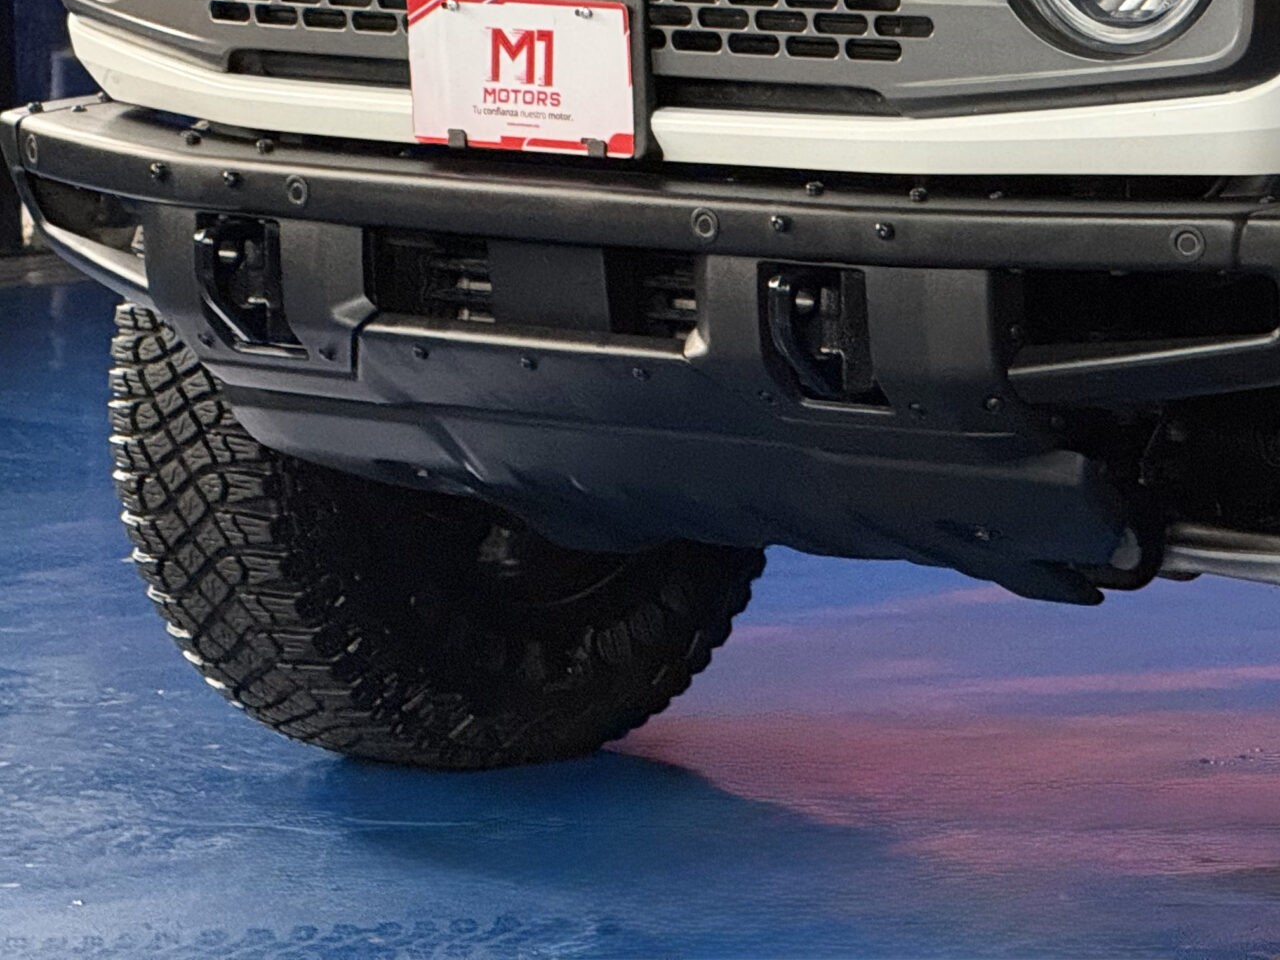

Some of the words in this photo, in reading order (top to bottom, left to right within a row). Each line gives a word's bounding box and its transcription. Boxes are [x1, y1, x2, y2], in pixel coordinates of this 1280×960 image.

[485, 26, 554, 87] M1
[483, 87, 561, 107] MOTORS
[472, 105, 482, 115] Tu
[483, 106, 519, 117] confianza
